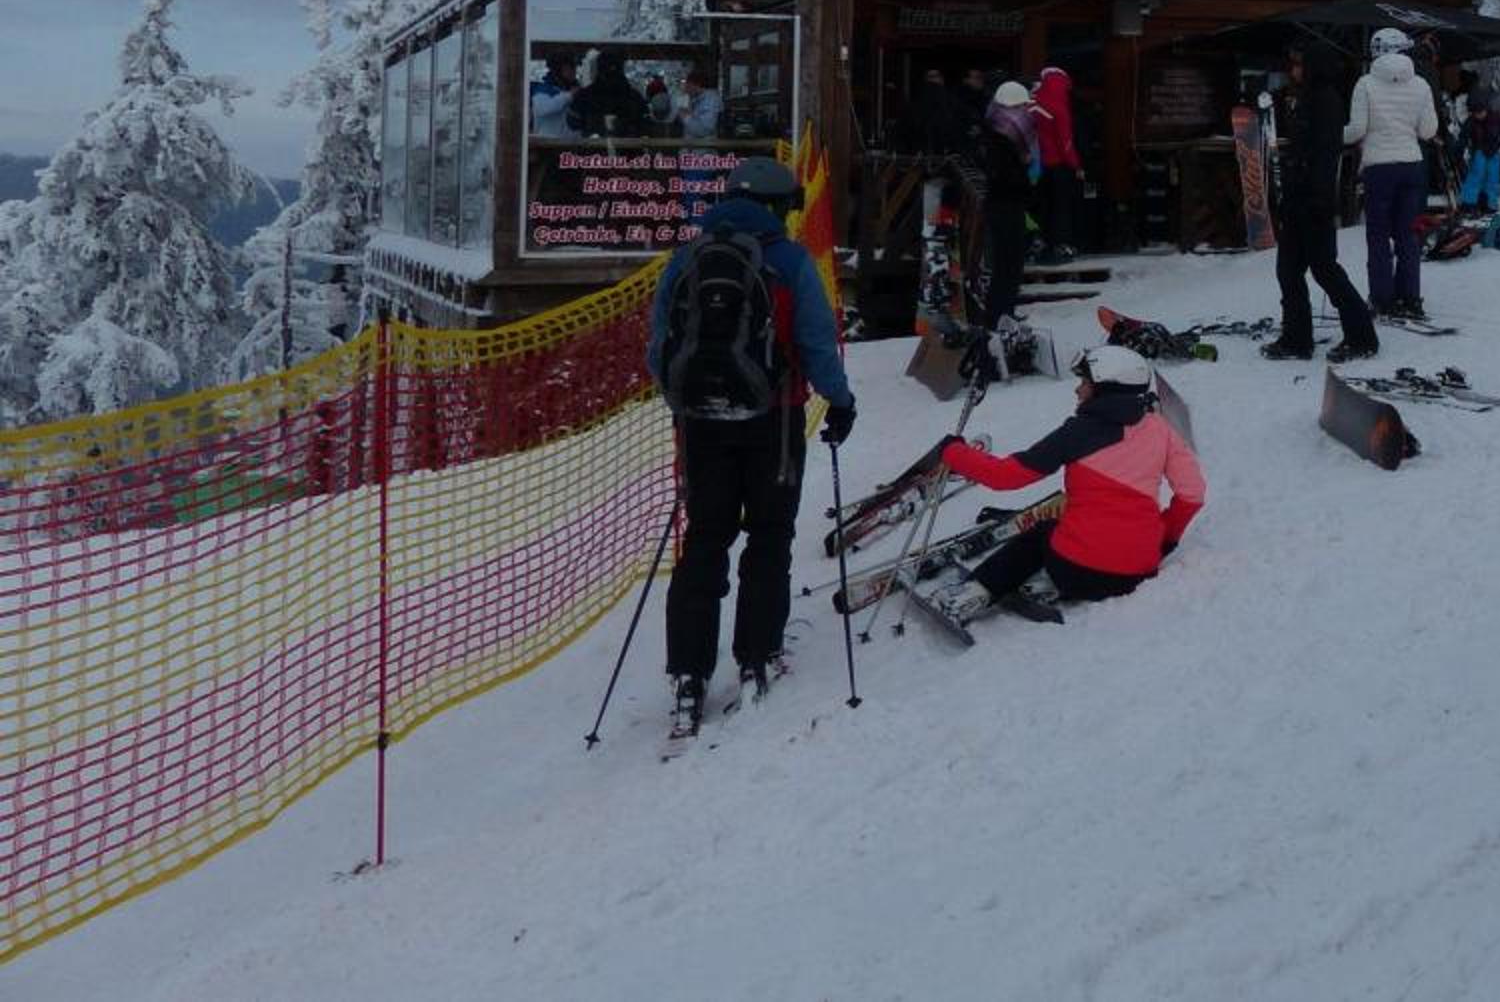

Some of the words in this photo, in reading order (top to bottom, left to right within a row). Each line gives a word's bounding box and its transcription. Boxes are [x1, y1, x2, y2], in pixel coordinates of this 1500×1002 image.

[559, 152, 651, 169] Bratwurst
[653, 154, 677, 169] im
[679, 151, 740, 169] Brötch
[583, 176, 665, 195] HotDogs,
[529, 201, 596, 221] Suppen
[609, 201, 688, 221] Eintöpfe,
[533, 225, 621, 245] Getränke,
